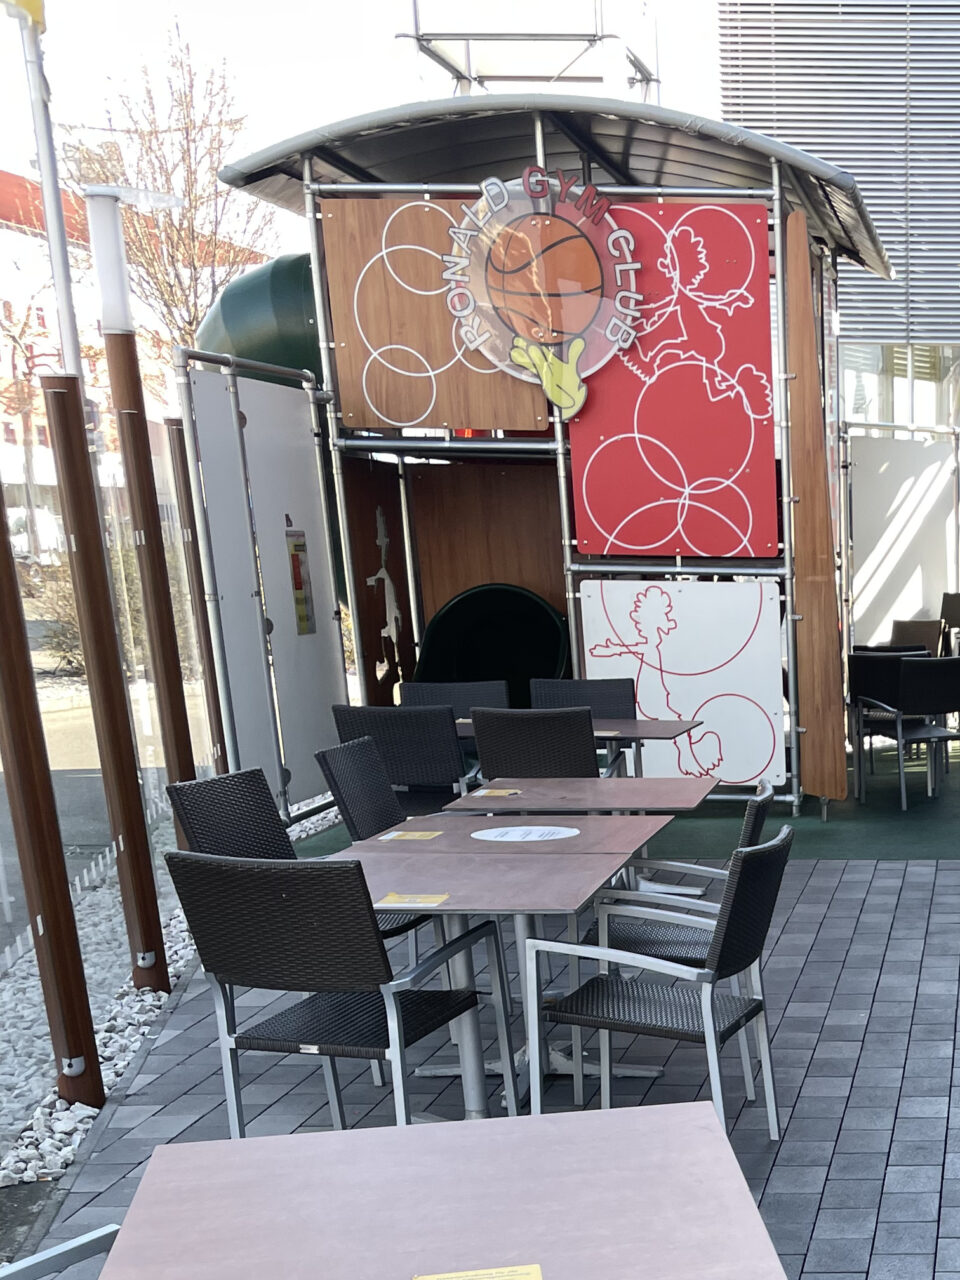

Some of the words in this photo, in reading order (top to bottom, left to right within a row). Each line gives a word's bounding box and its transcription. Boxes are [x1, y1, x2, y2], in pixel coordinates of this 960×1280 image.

[442, 176, 509, 351] RONALD
[522, 166, 612, 226] GYM
[605, 228, 644, 350] CLUB
